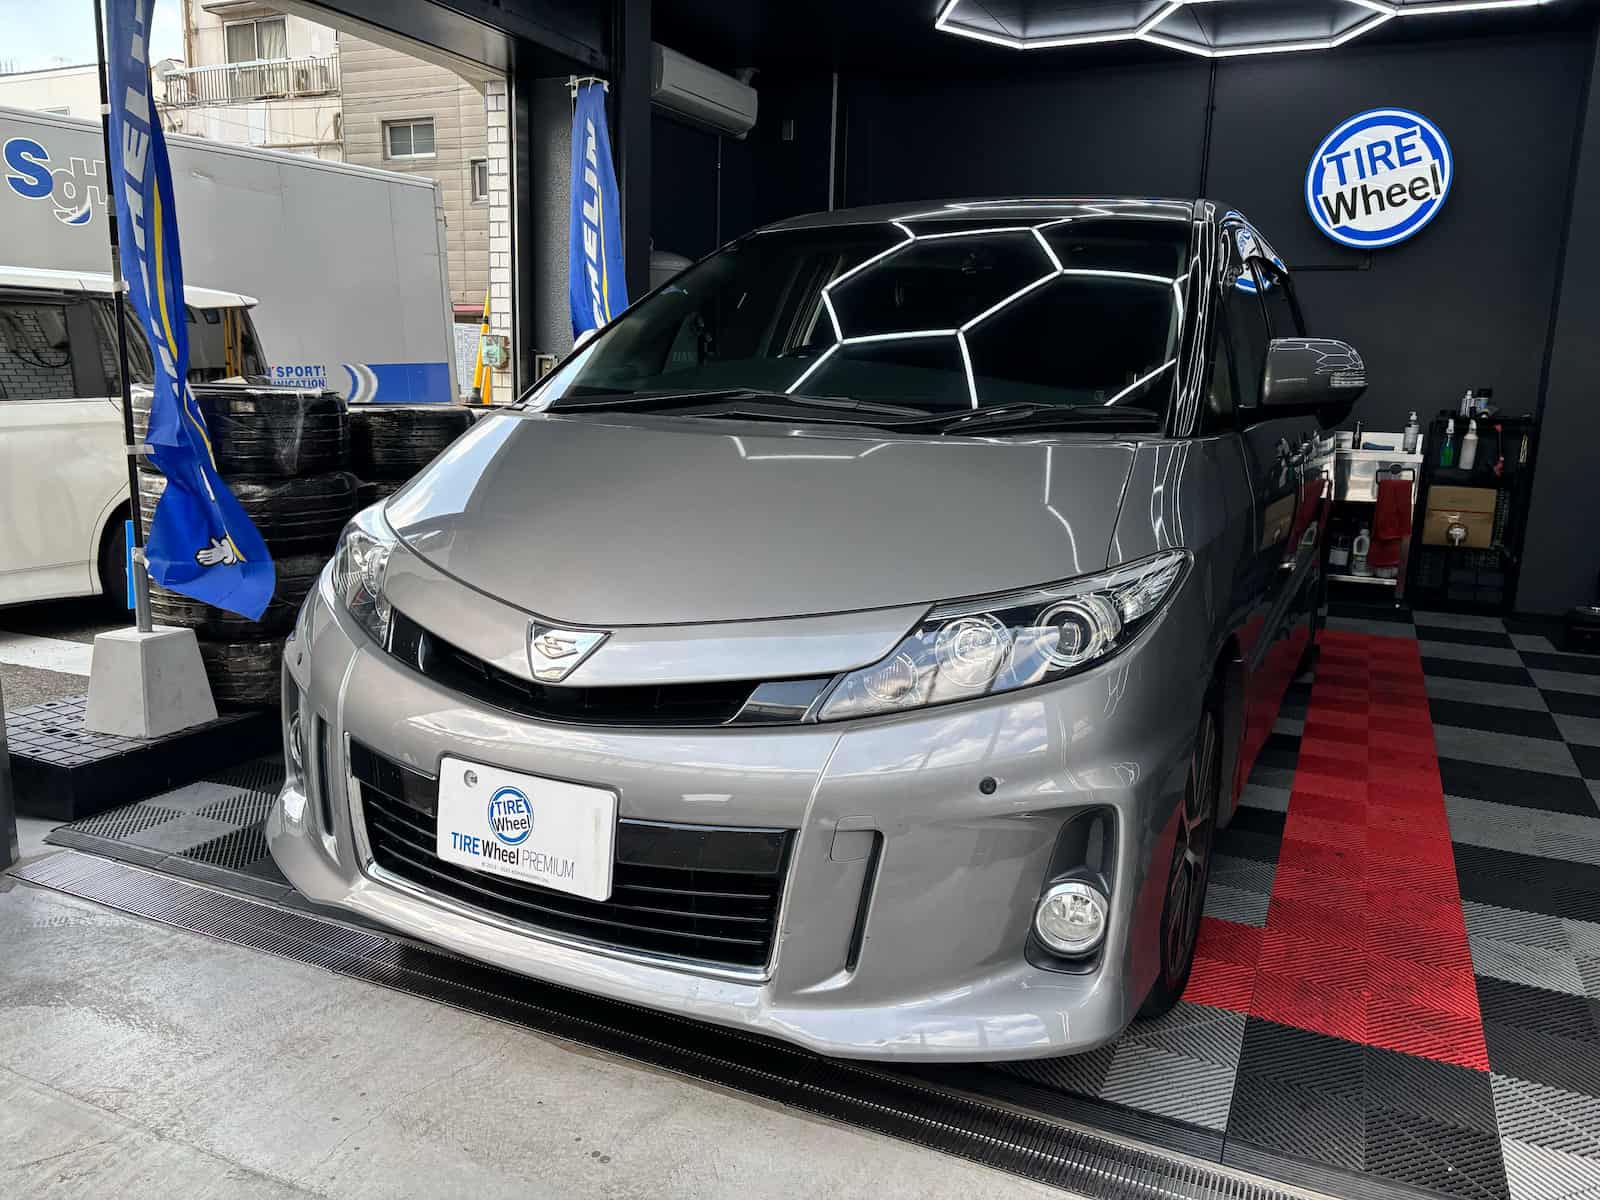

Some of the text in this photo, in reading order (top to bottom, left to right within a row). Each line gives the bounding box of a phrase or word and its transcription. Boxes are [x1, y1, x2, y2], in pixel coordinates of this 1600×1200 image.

[1326, 130, 1422, 186] TIRE
[1321, 163, 1442, 226] Wheel
[493, 815, 530, 832] Wheel
[494, 798, 525, 815] TIRE
[451, 831, 480, 856] TIRE
[481, 839, 519, 866] Wheel
[522, 849, 576, 880] PREMIUM
